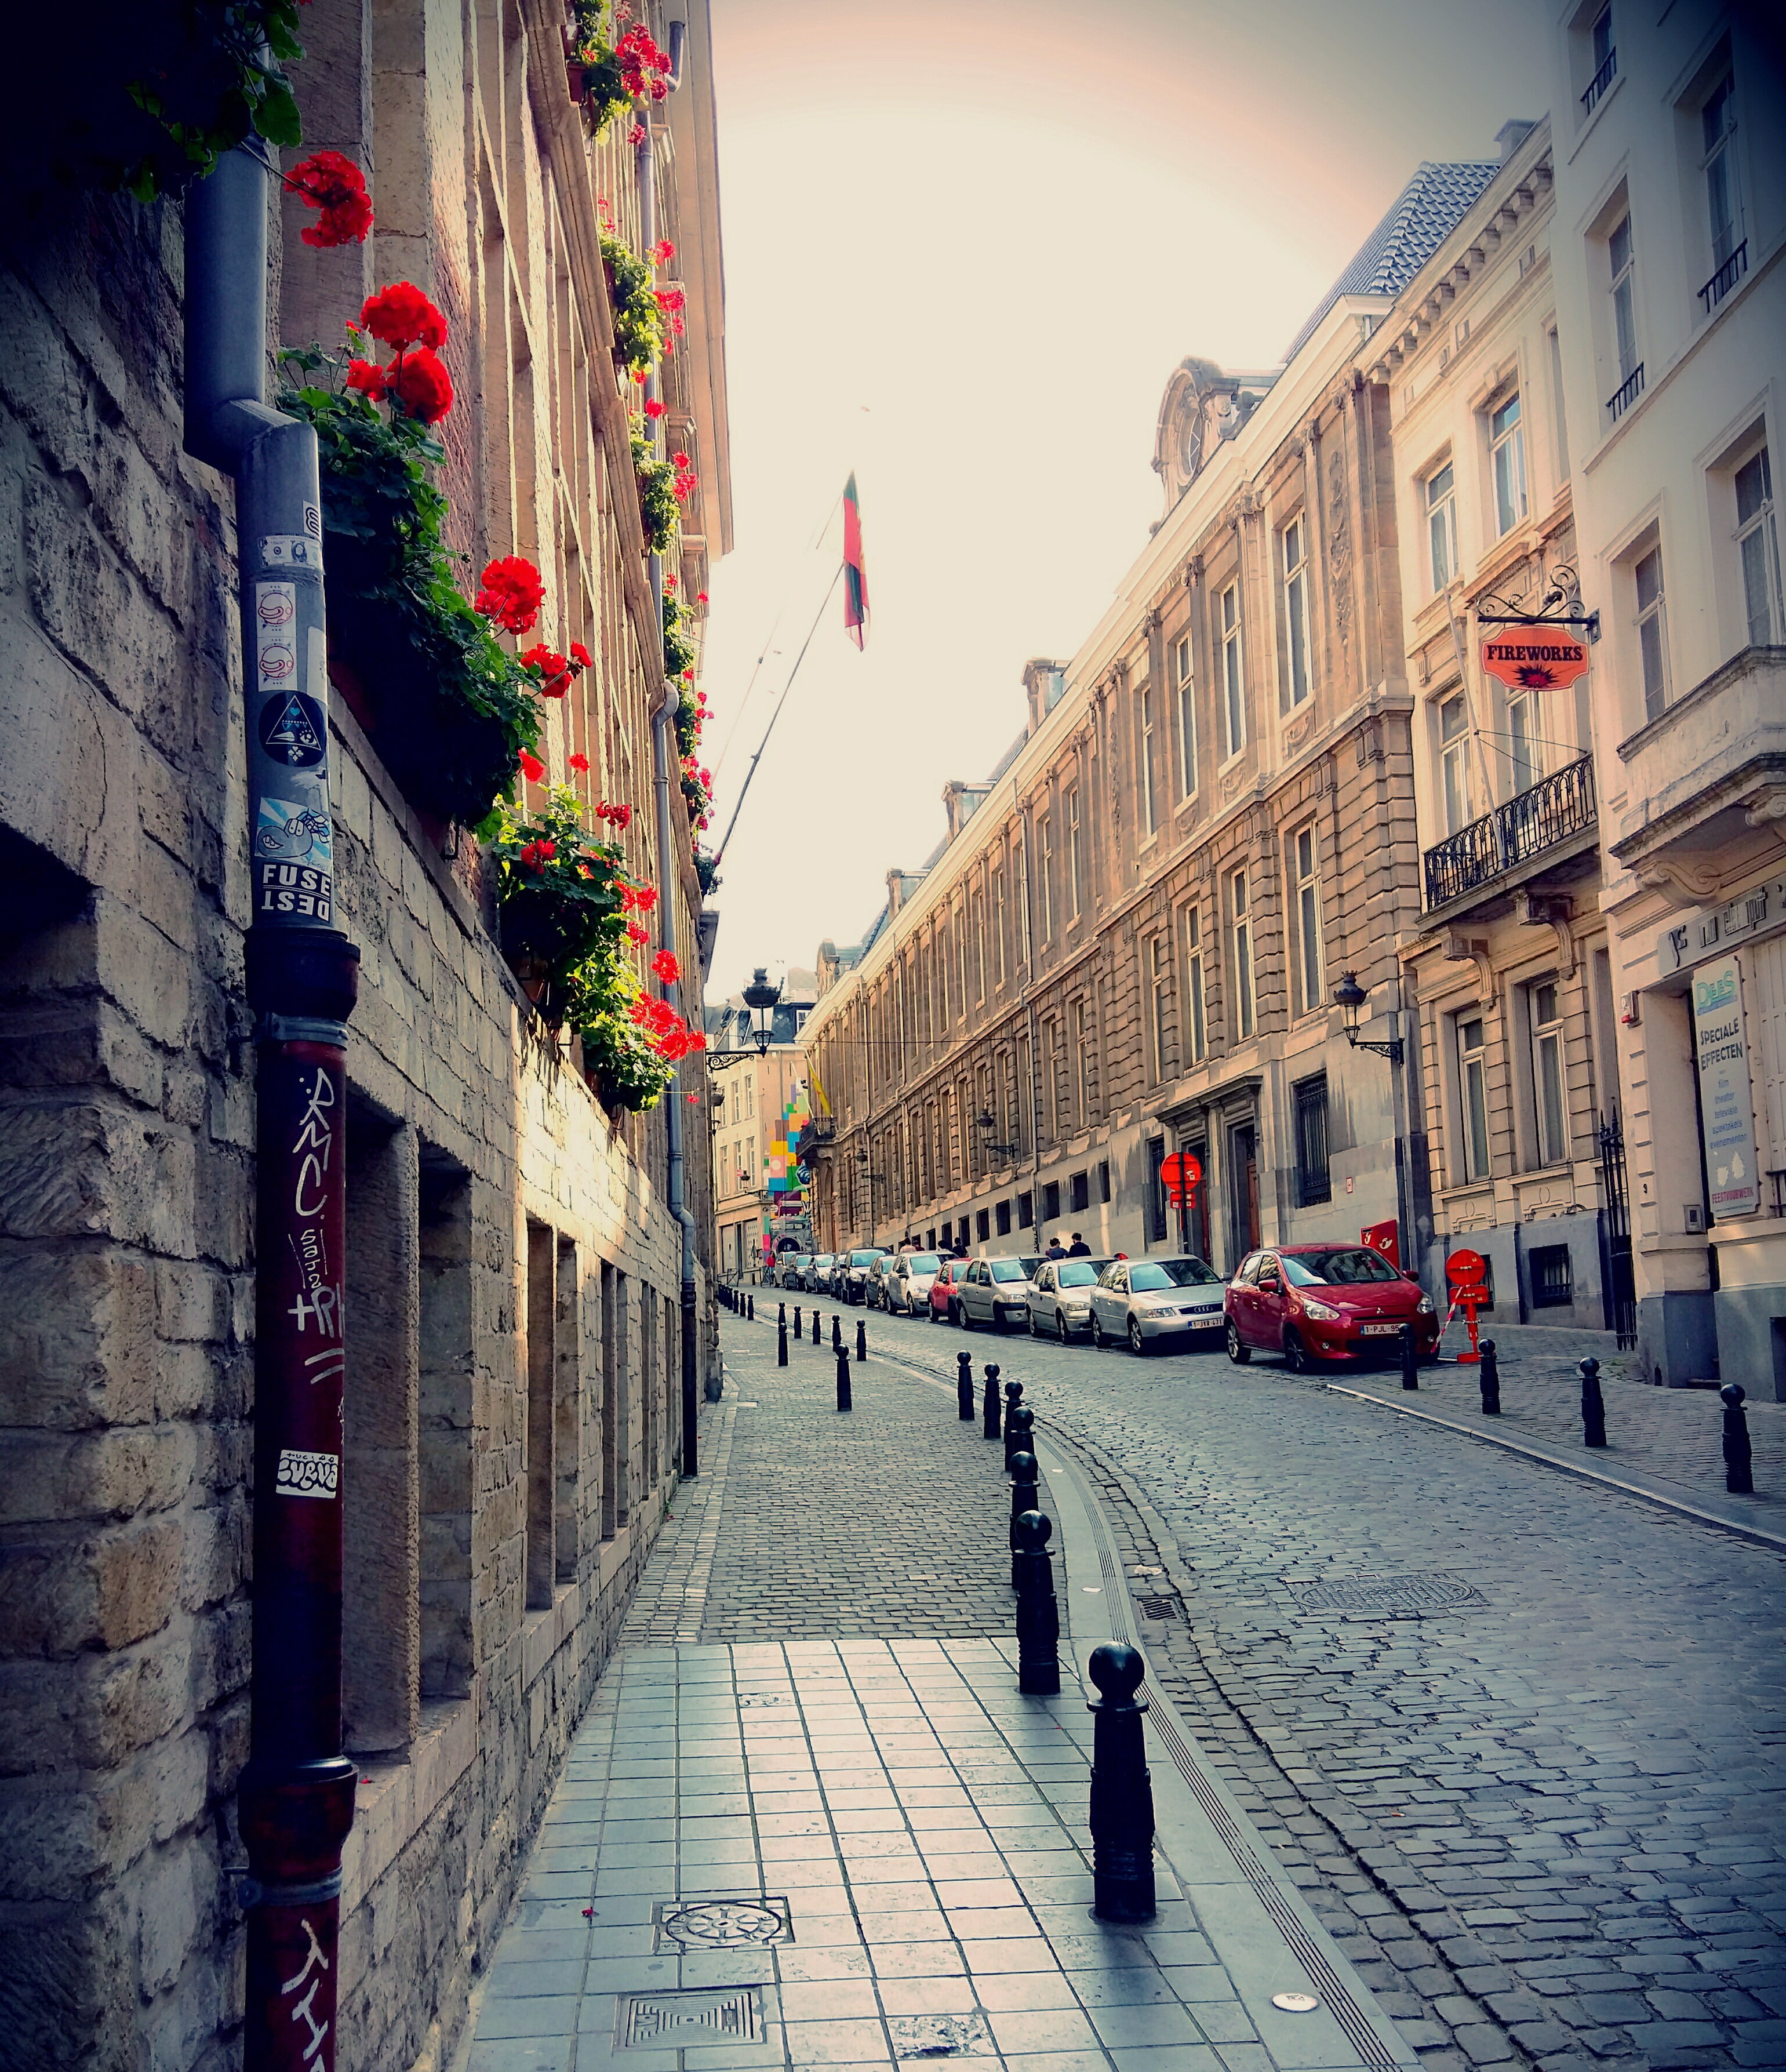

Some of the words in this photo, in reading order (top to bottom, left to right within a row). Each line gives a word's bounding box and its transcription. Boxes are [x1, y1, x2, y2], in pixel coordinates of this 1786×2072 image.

[1487, 645, 1583, 661] FIREWORKS
[263, 864, 331, 896] FUSE
[1700, 1016, 1740, 1046] SPECIALE
[1701, 1041, 1743, 1071] EFFECTEN
[1643, 1183, 1647, 1194] 9
